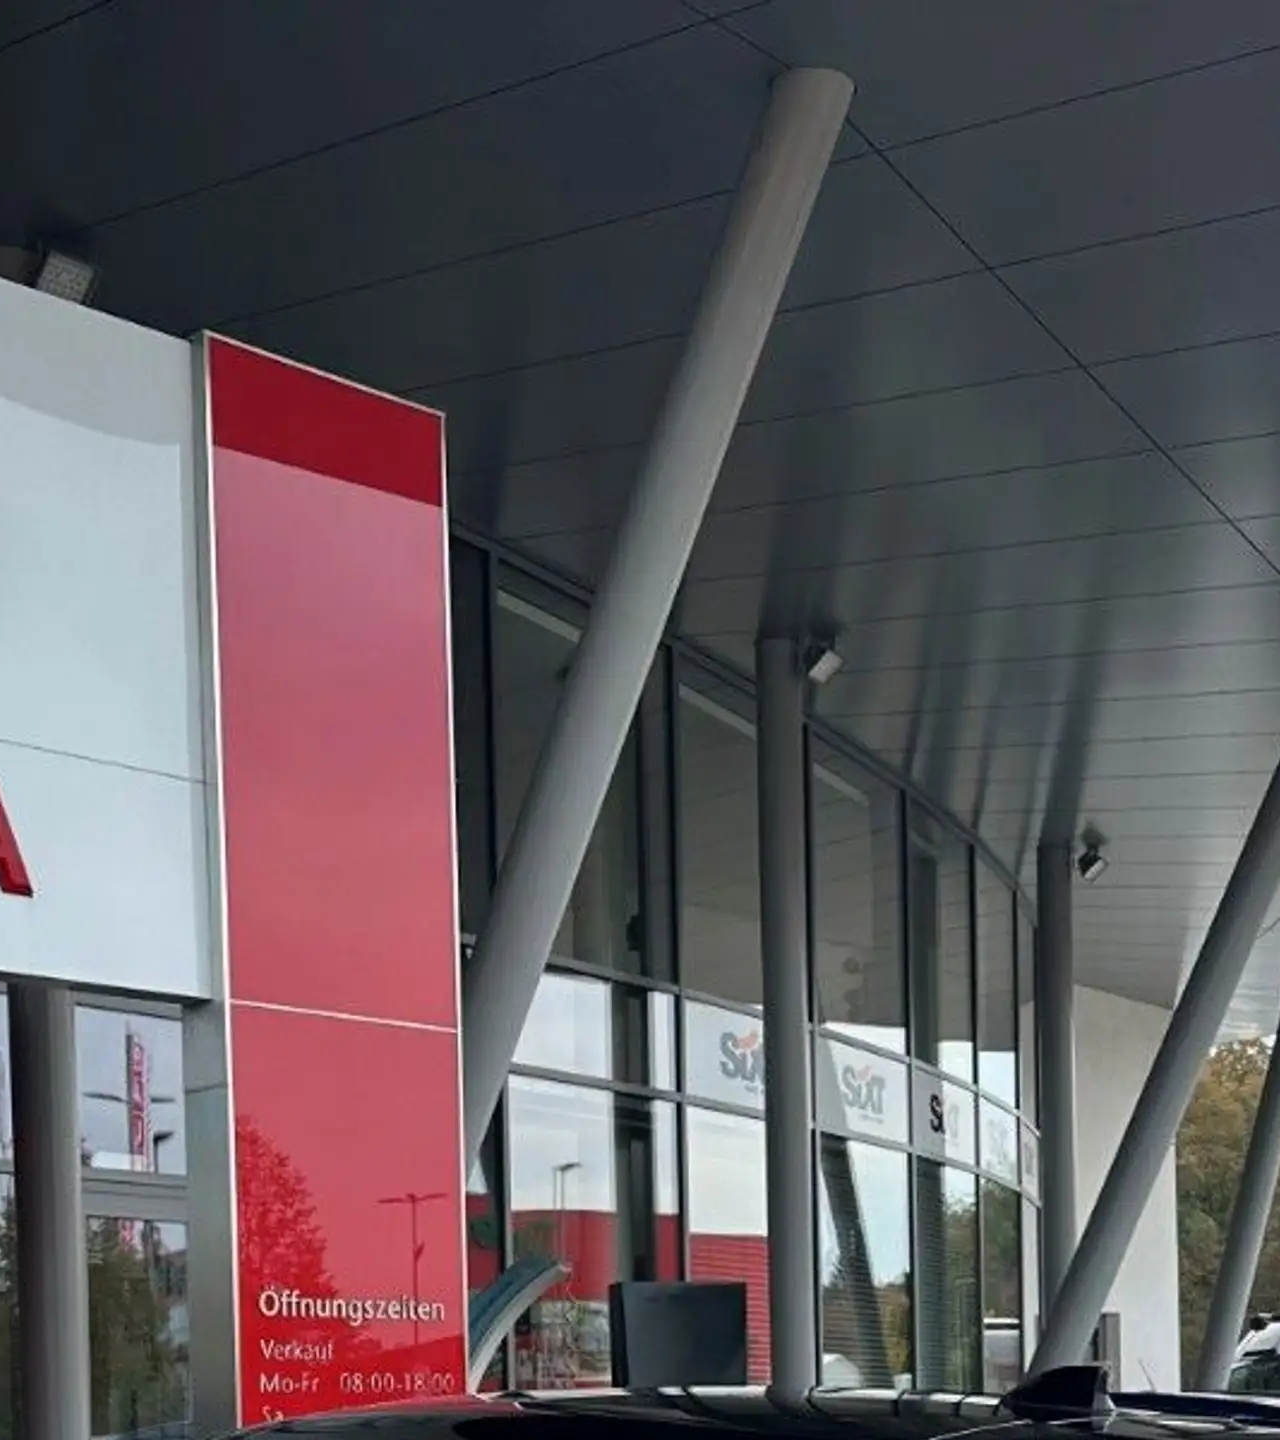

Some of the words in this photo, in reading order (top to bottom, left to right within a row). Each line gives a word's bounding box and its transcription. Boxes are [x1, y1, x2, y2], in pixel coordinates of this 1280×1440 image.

[841, 1063, 887, 1115] SIXT
[259, 1285, 446, 1327] Öffnungszeiten
[260, 1372, 320, 1394] Mo-Fr
